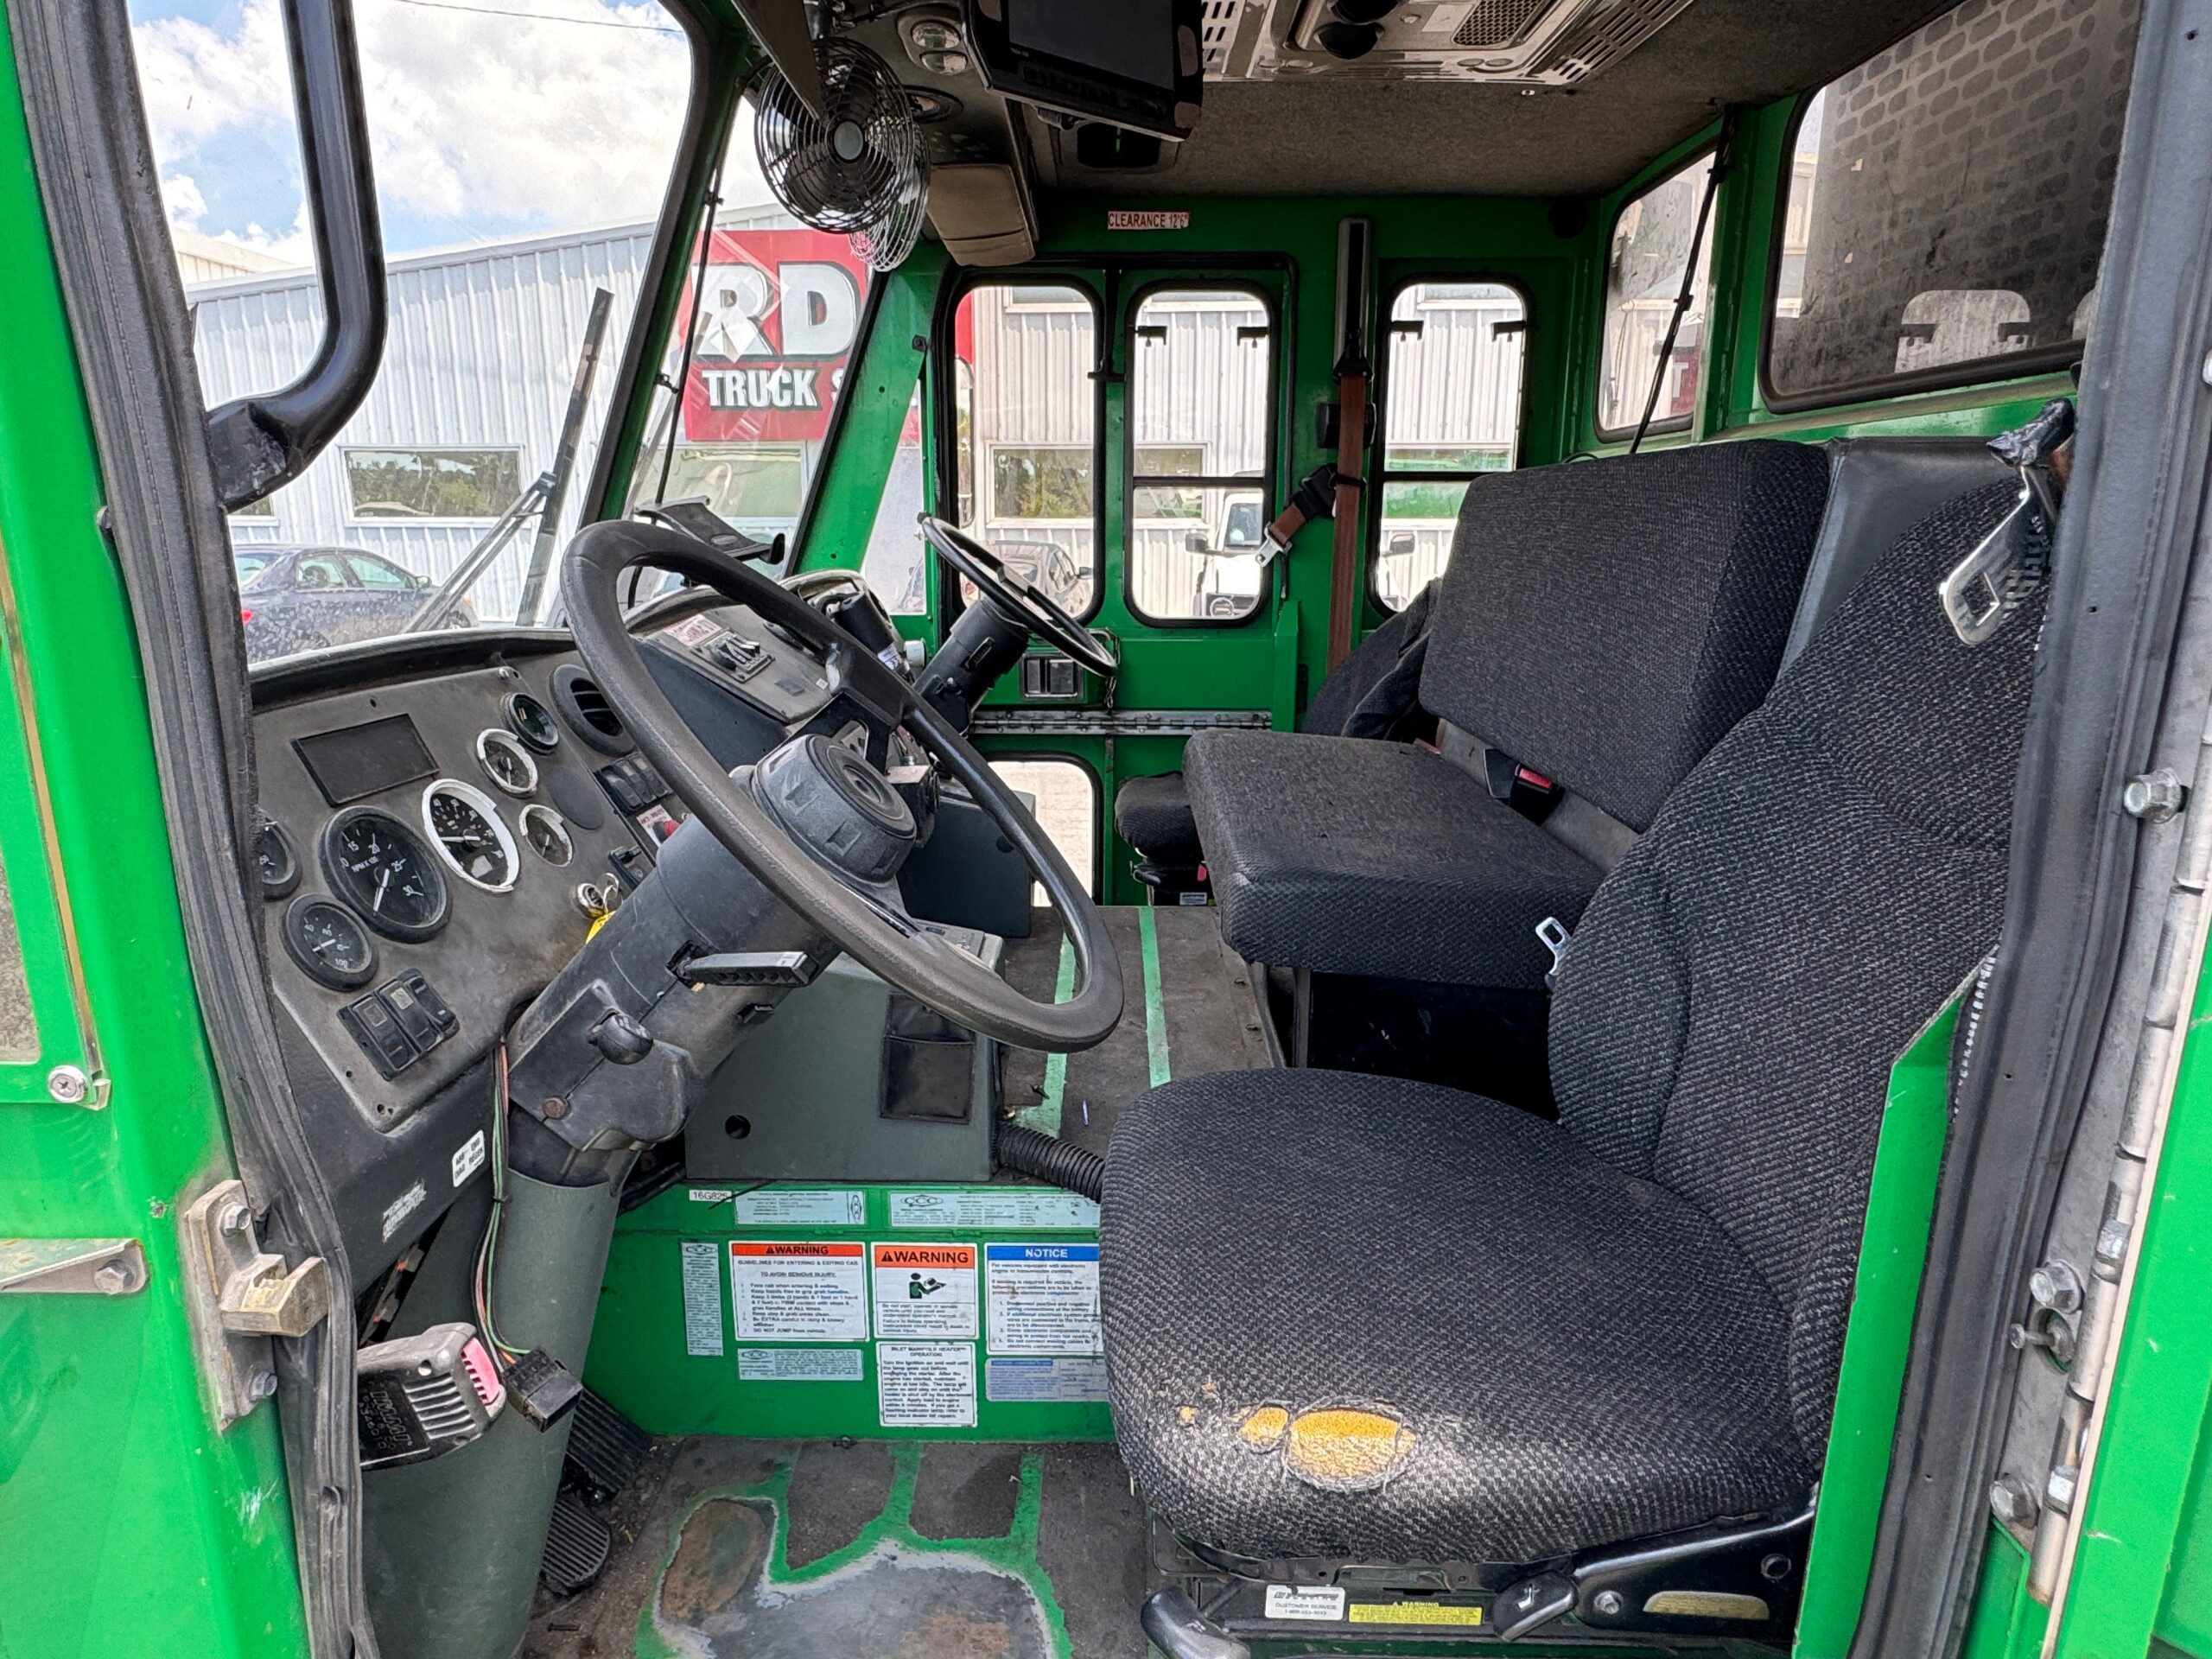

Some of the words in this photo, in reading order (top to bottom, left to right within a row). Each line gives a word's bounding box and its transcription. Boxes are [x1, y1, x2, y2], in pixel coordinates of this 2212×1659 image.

[1109, 213, 1165, 227] CLEARANCE
[702, 368, 820, 409] TRUCK
[348, 841, 359, 852] 15
[369, 843, 380, 854] 20
[391, 860, 403, 872] 25
[403, 885, 414, 896] 30
[775, 1246, 829, 1255] WARNING
[1025, 1249, 1068, 1258] NOTICE
[894, 1251, 969, 1263] WARNING
[369, 1391, 411, 1442] IMMI
